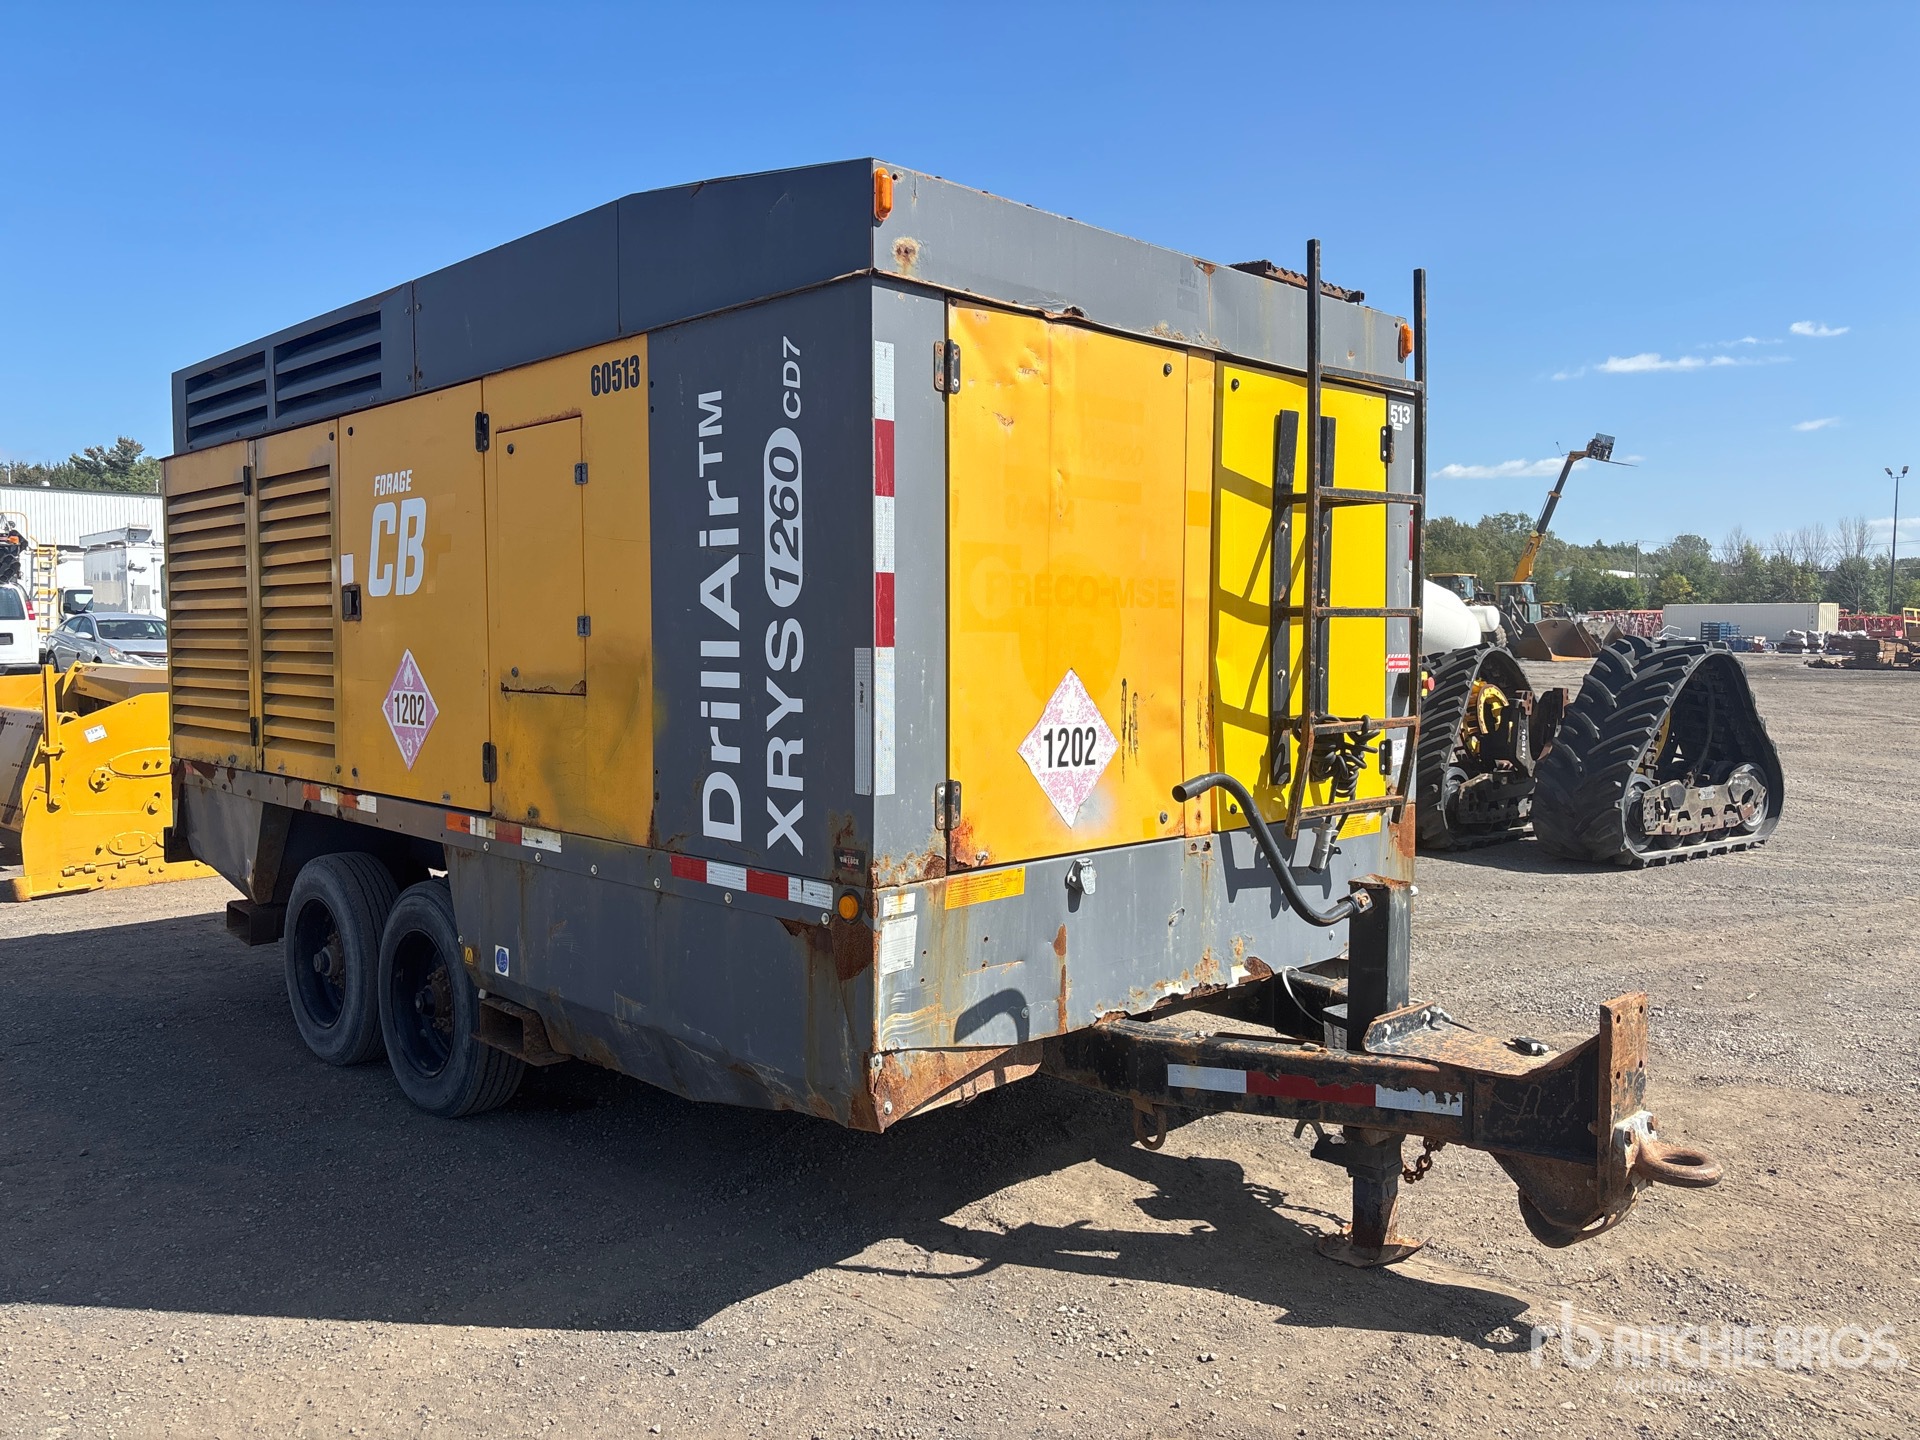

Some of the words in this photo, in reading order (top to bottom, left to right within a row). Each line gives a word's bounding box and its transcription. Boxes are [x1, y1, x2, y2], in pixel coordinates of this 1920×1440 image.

[590, 354, 641, 397] 60513
[782, 336, 802, 420] CD7
[1390, 404, 1411, 425] 513
[374, 469, 413, 498] FORAGE
[768, 445, 802, 597] 1260
[367, 496, 427, 598] CB
[394, 692, 425, 727] 1202
[764, 618, 804, 856] XRYS
[1043, 726, 1097, 768] 1202
